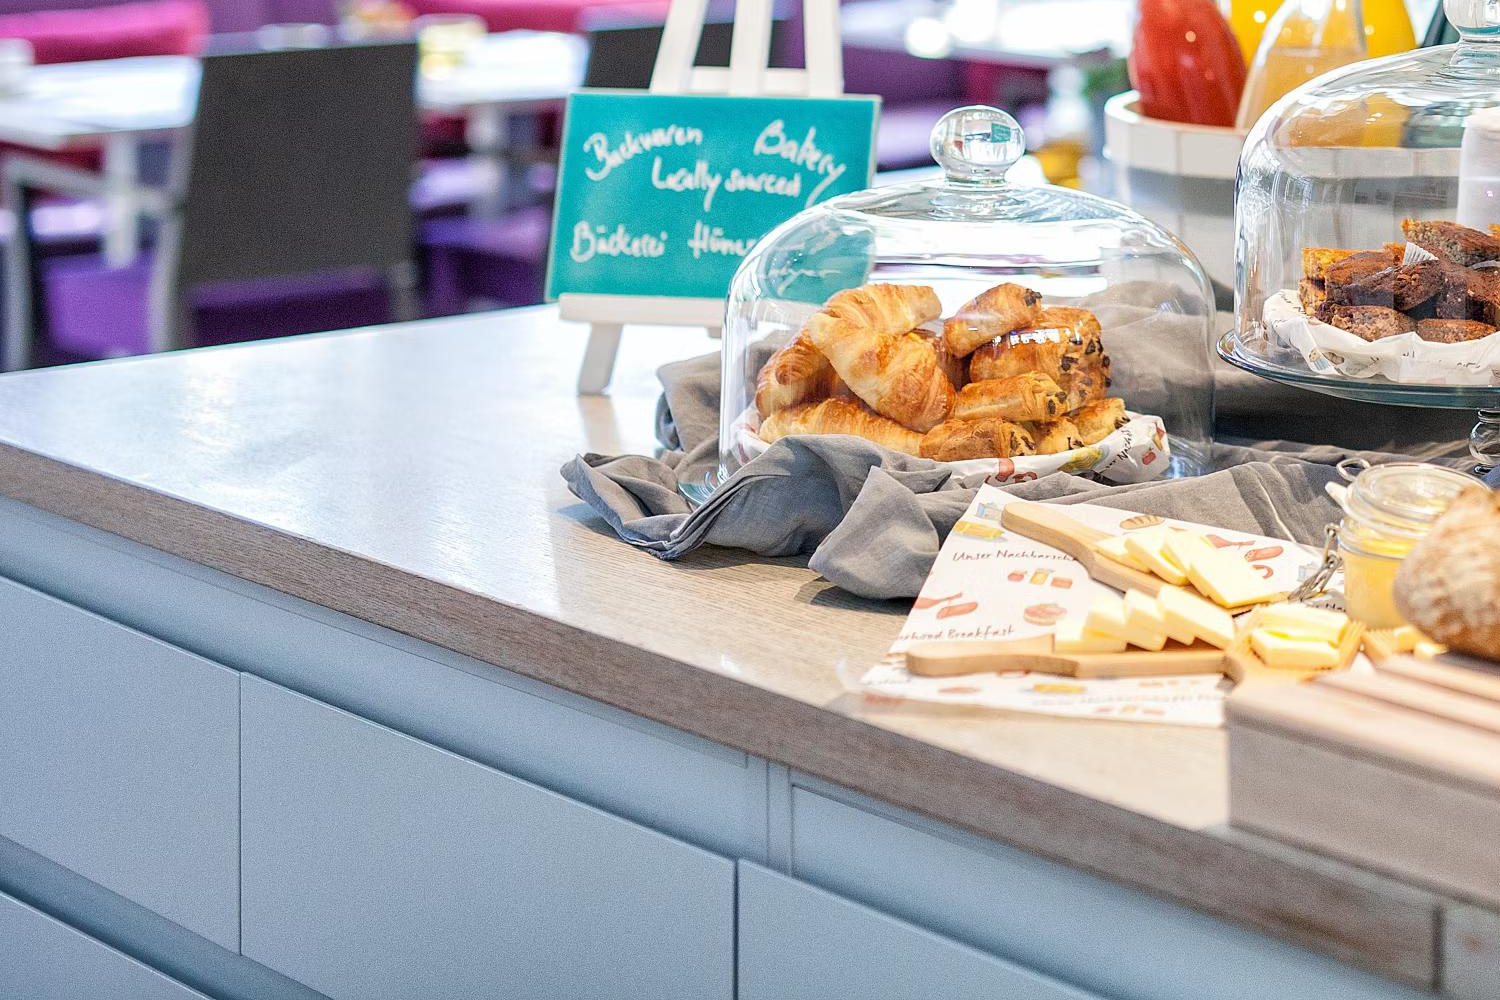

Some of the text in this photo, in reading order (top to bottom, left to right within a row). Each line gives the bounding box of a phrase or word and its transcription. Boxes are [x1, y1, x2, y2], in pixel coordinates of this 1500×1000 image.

[753, 118, 848, 210] Bakery
[569, 219, 669, 264] Bäckerei
[952, 551, 992, 562] Unser
[947, 623, 1016, 641] Breakfast
